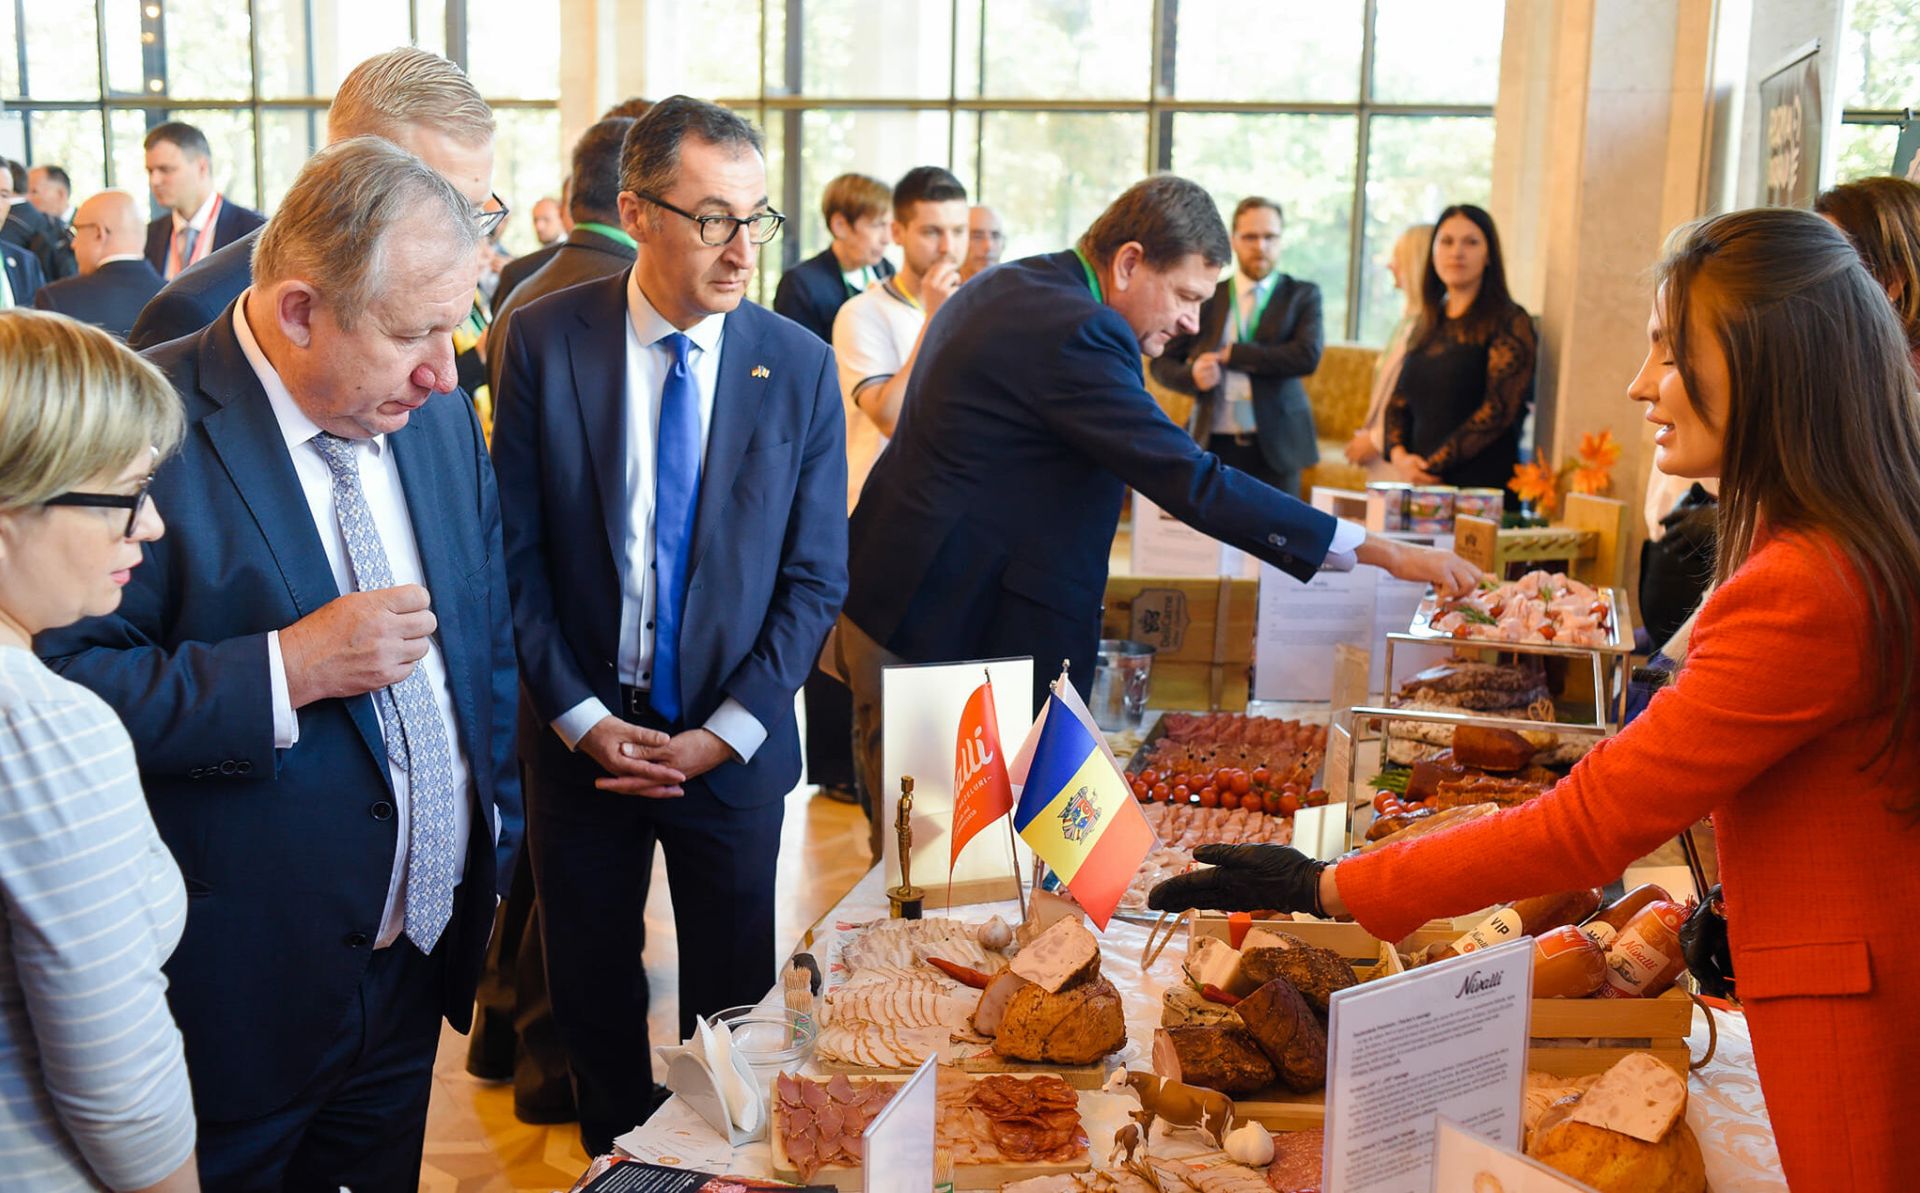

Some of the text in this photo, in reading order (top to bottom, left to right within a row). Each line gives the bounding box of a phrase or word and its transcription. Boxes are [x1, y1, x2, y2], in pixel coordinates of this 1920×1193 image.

[954, 725, 993, 799] alli
[1490, 917, 1510, 935] VIP
[1469, 931, 1489, 950] Nivall
[1620, 940, 1658, 971] Nivalli
[1455, 970, 1502, 998] Nivalli
